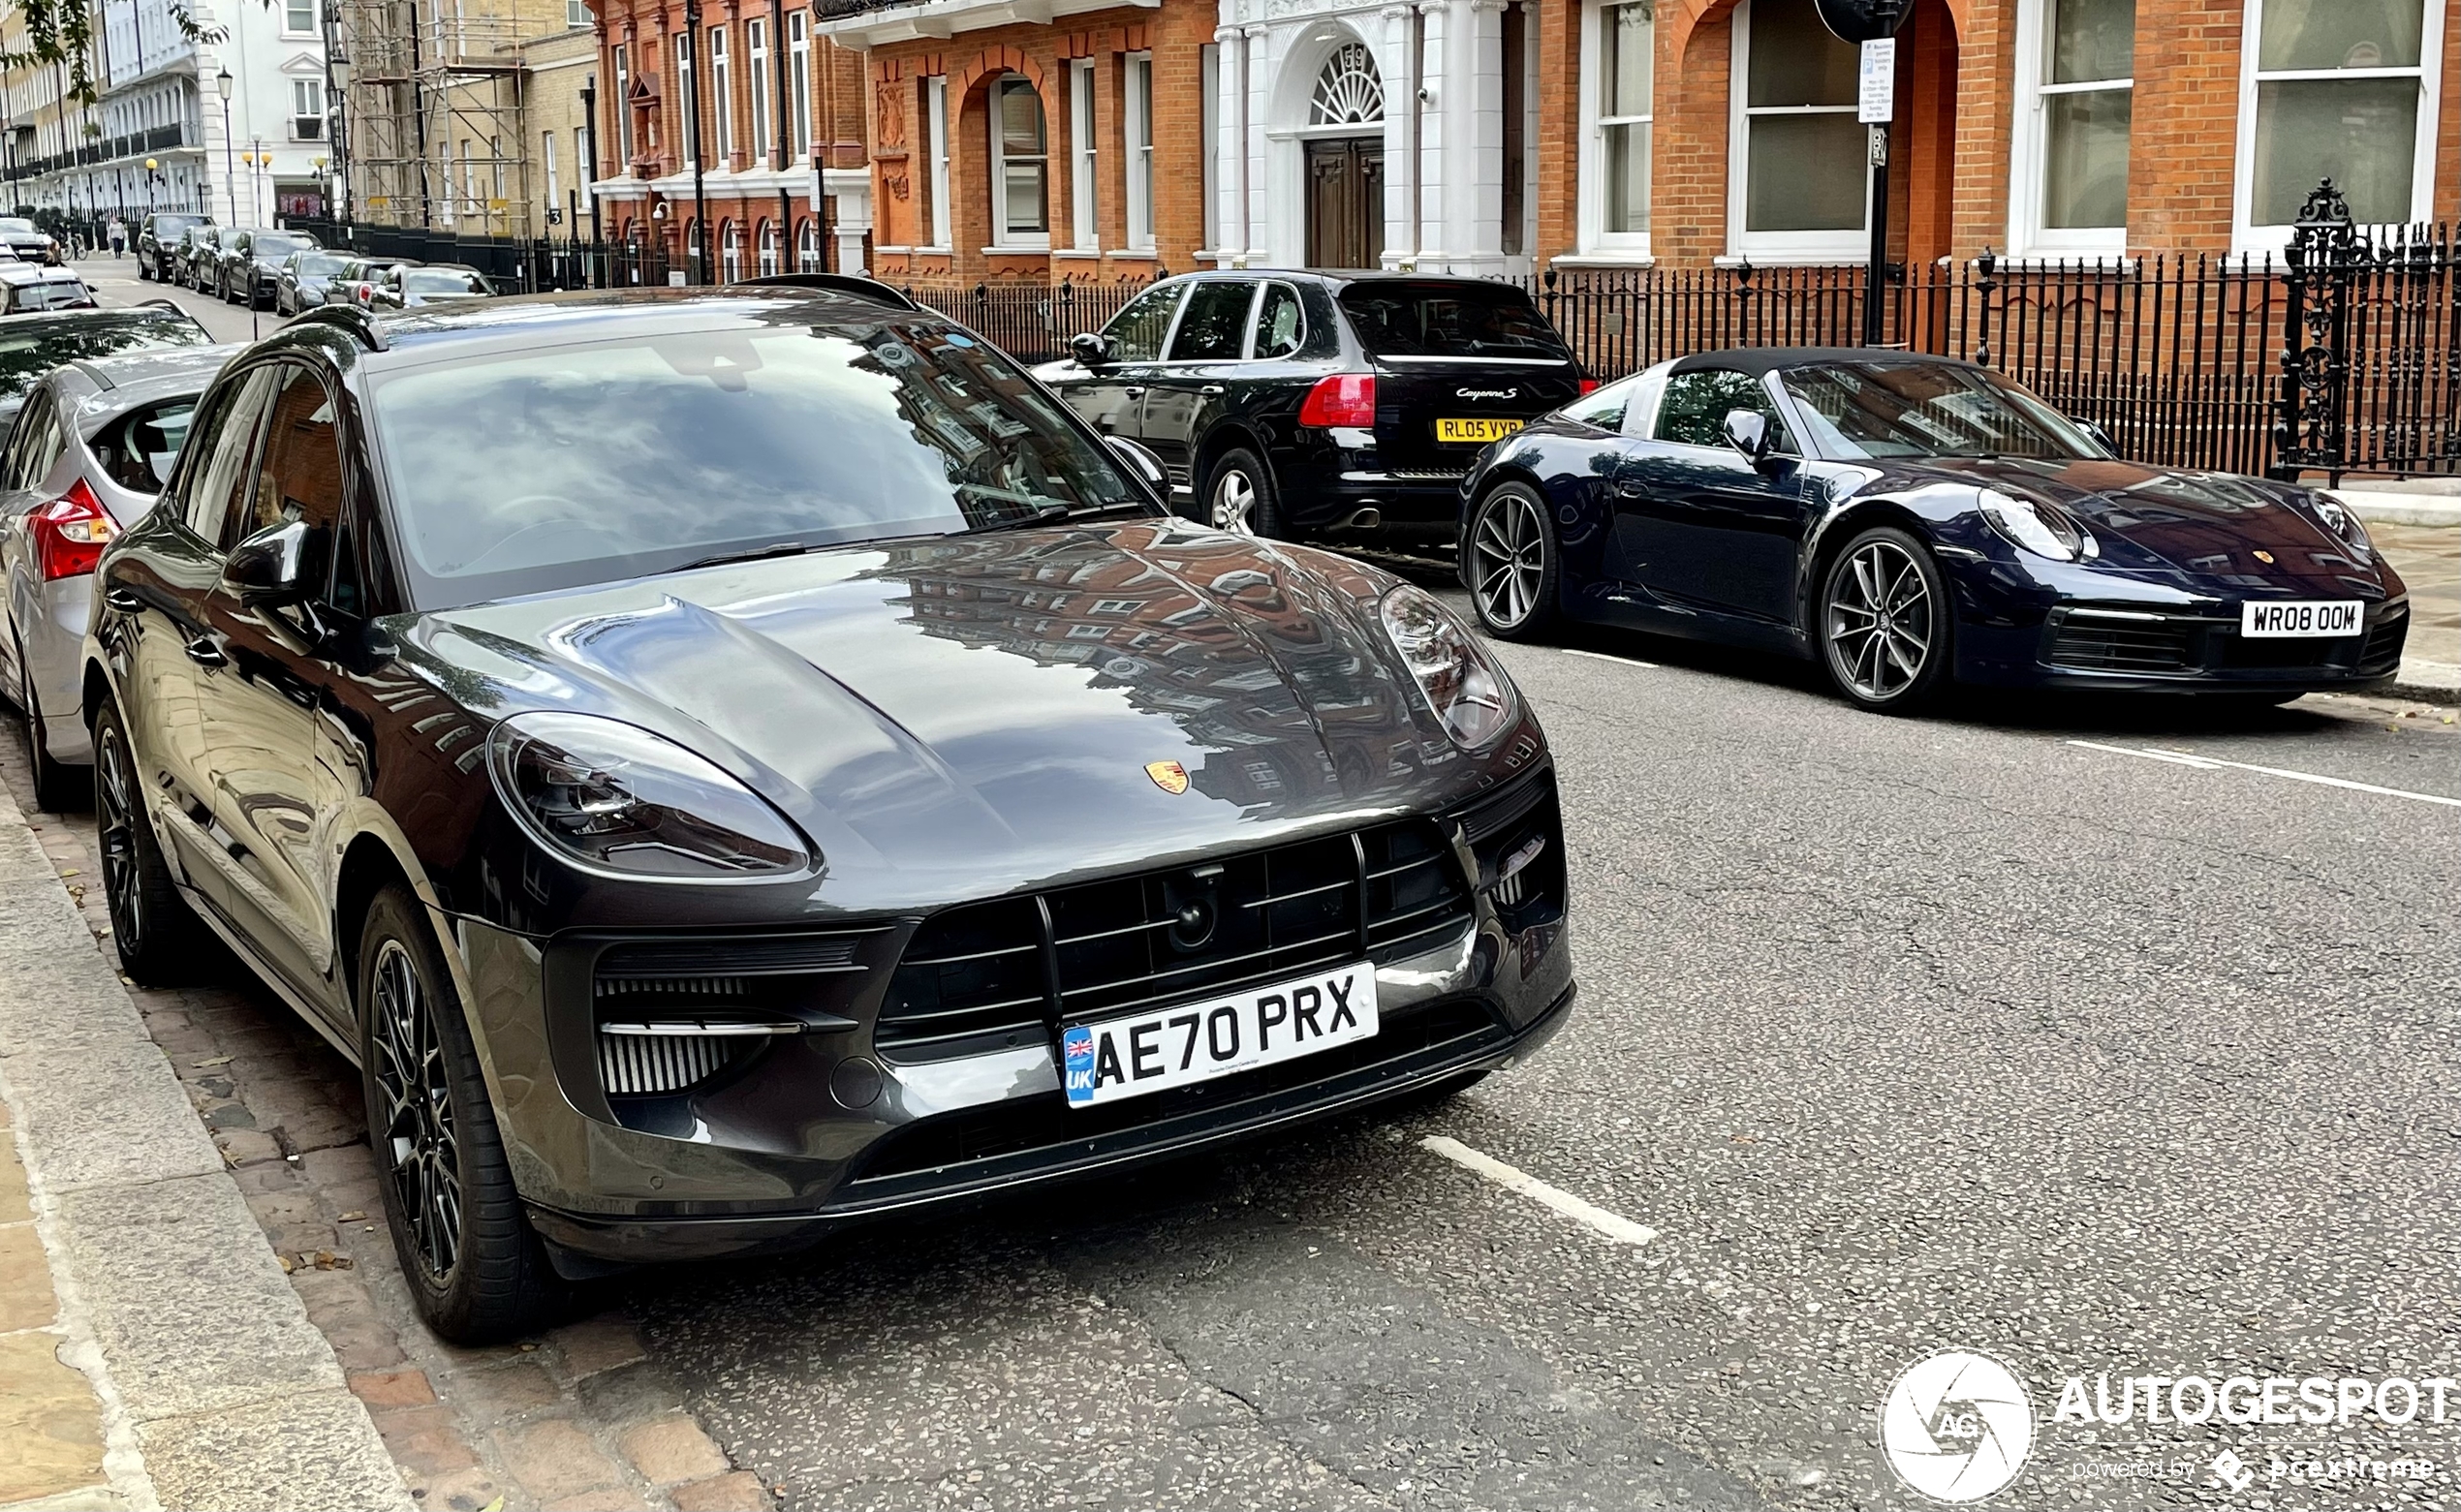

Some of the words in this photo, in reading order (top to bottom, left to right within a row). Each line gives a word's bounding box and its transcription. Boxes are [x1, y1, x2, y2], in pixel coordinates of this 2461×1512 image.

[1344, 48, 1364, 68] 59
[551, 210, 560, 224] 3
[1456, 387, 1504, 401] Cayenne
[1504, 388, 1517, 399] S
[1445, 421, 1485, 438] RL05
[2254, 606, 2312, 632] WR08
[1093, 1005, 1240, 1090] AE70
[1257, 974, 1357, 1052] PRX
[1067, 1068, 1093, 1091] UK
